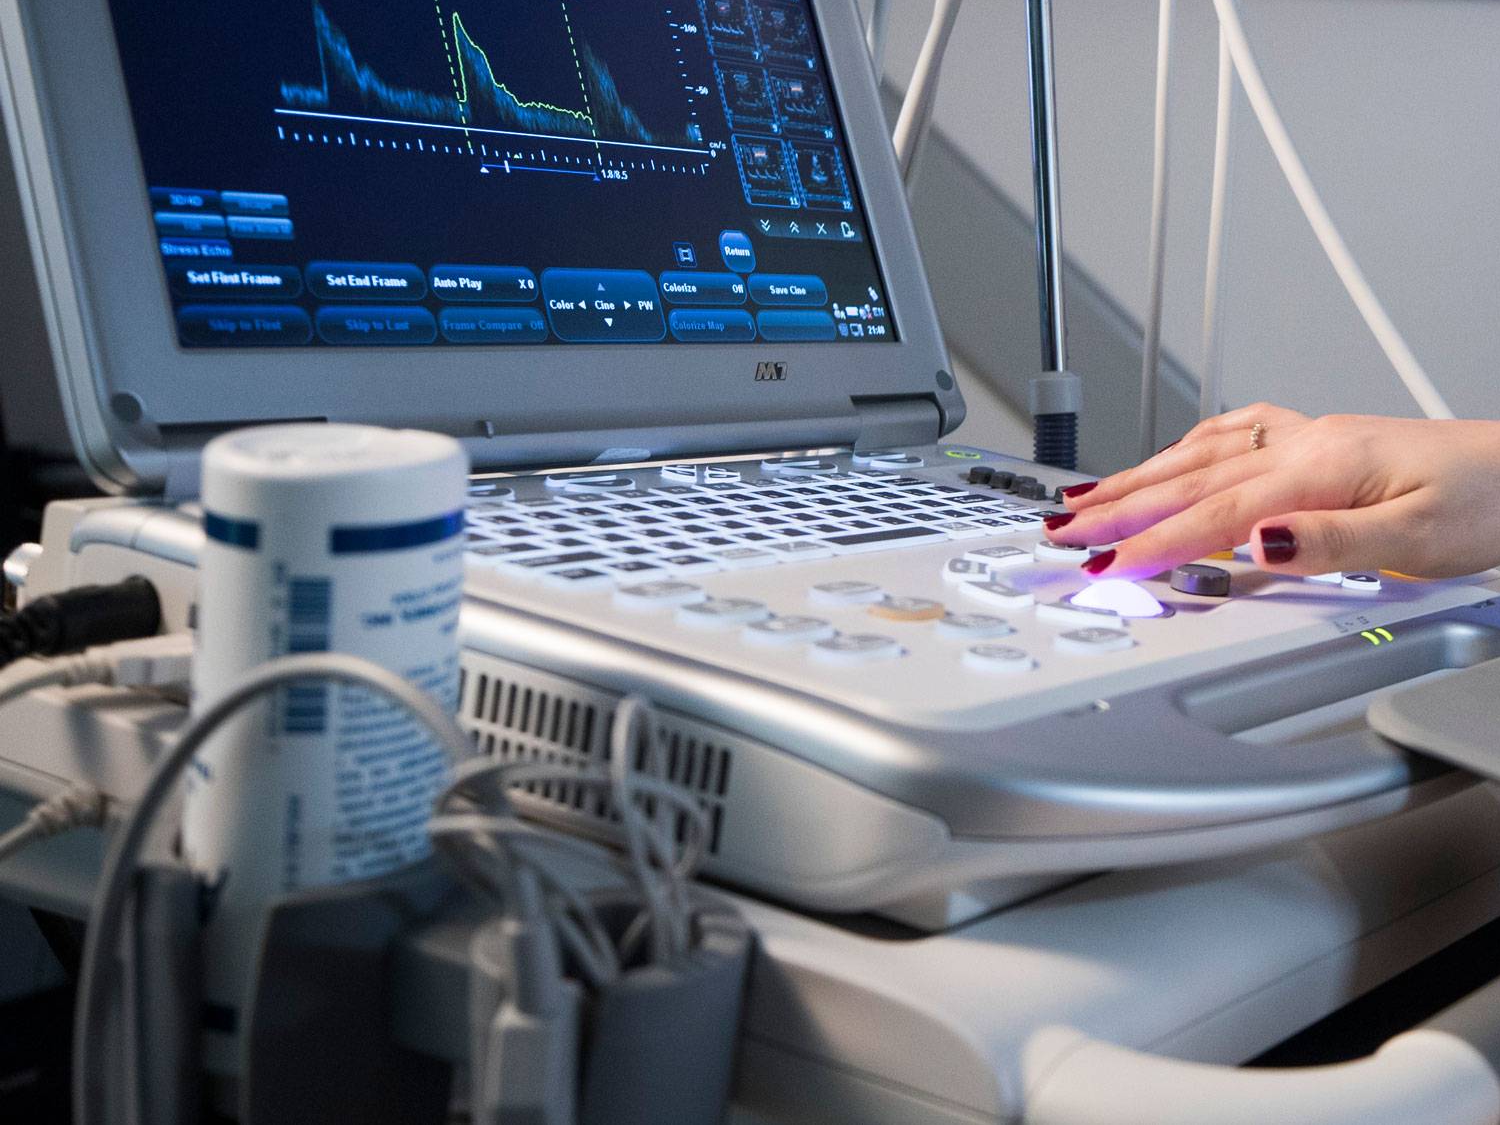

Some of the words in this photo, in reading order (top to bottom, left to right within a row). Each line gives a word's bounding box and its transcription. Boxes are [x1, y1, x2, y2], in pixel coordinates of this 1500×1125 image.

[789, 197, 799, 206] 11
[843, 201, 851, 209] 12
[725, 246, 751, 257] Return
[187, 270, 211, 283] Set
[211, 271, 241, 284] First
[240, 271, 281, 285] Frame
[326, 274, 347, 286] Set
[347, 275, 371, 287] End
[371, 275, 407, 287] Frame
[434, 277, 457, 288] Auto
[459, 277, 482, 291] Play
[518, 278, 527, 289] X
[663, 283, 697, 293] Colorize
[769, 285, 788, 295] Save
[789, 285, 806, 296] Cine
[550, 299, 574, 310] Color
[595, 300, 615, 310] Cine
[638, 300, 653, 310] PW
[254, 319, 281, 331] First
[444, 320, 476, 331] Frame
[673, 321, 707, 331] Colorize
